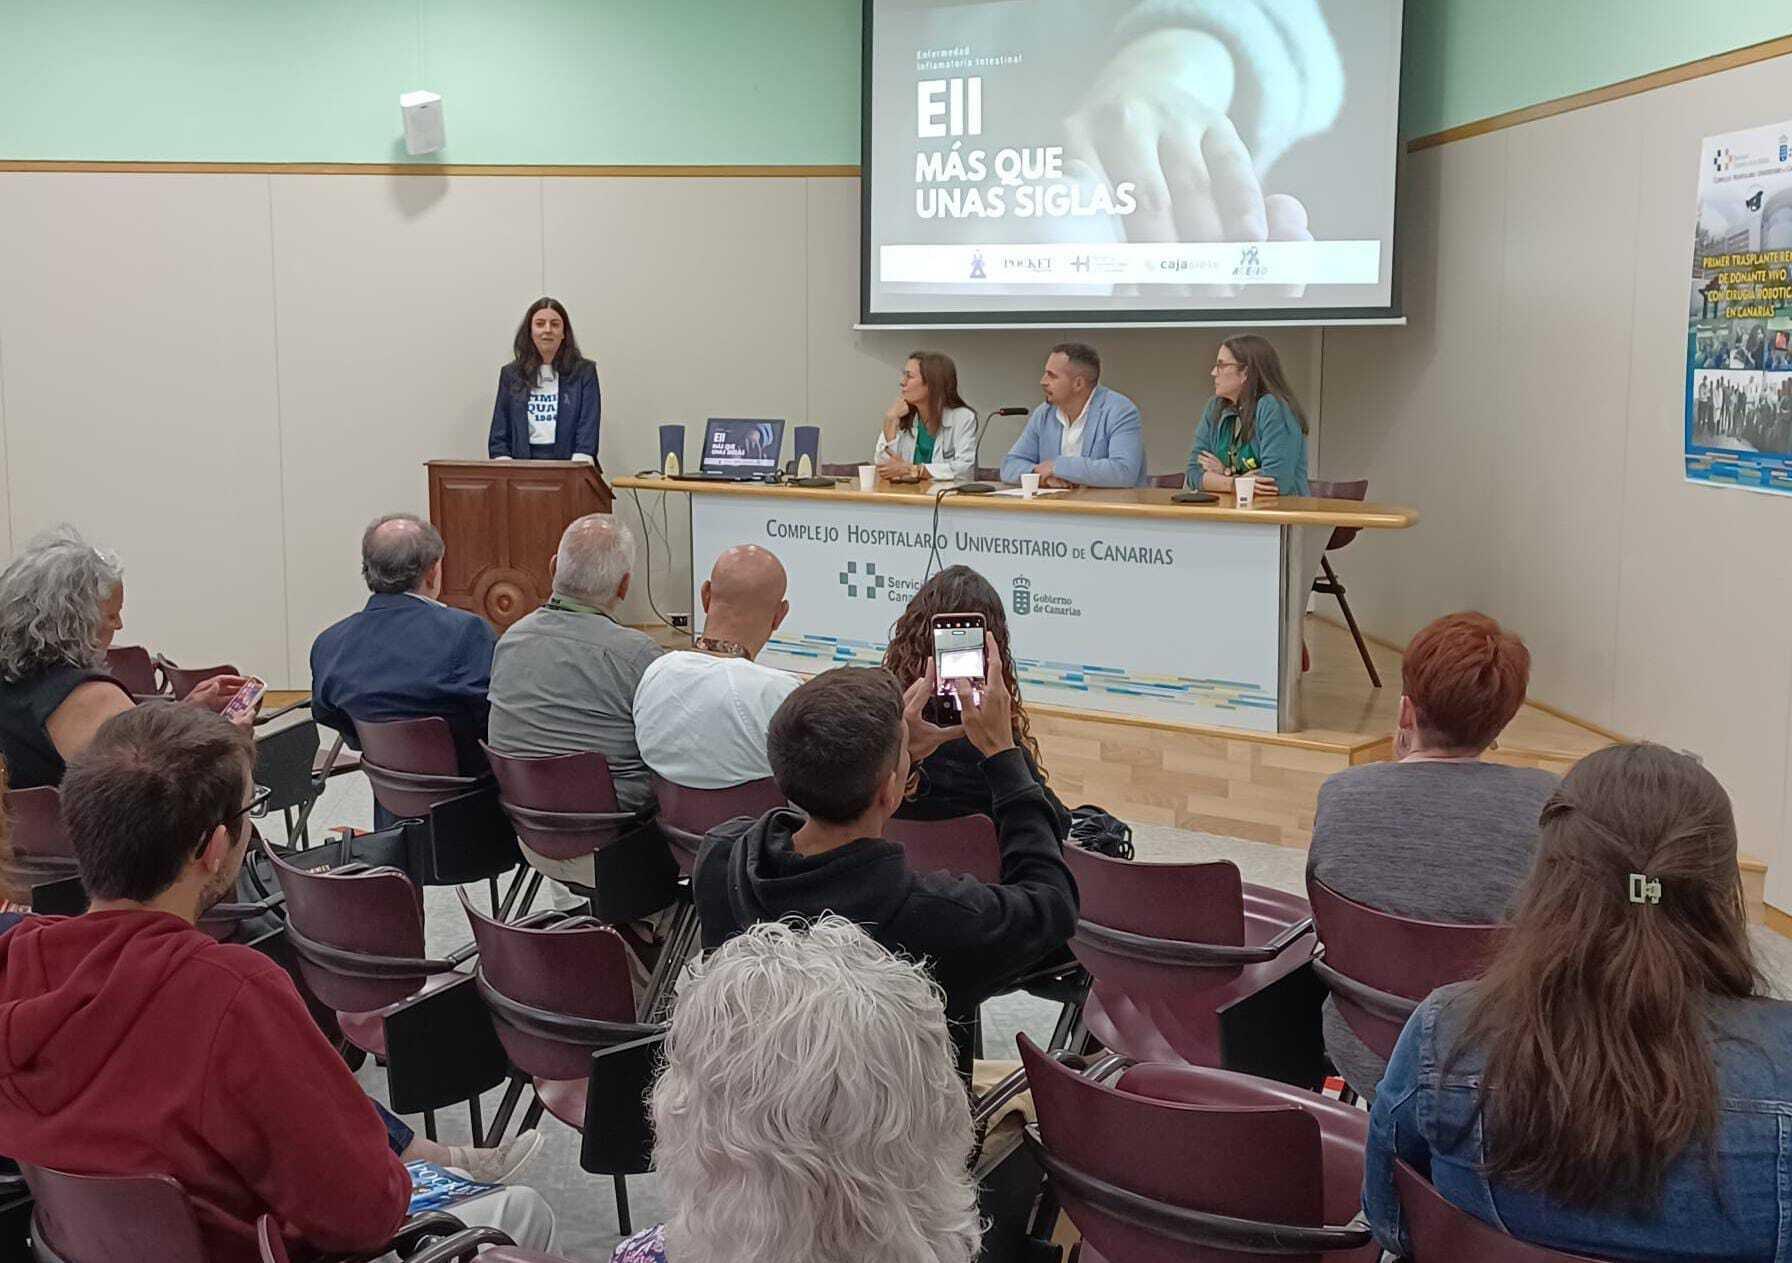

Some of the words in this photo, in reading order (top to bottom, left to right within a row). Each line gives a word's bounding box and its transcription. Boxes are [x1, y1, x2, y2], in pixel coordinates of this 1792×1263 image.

[915, 140, 987, 182] MÁS
[995, 147, 1063, 186] QUE
[915, 187, 1005, 218] UNAS
[1014, 182, 1137, 217] SIGLAS
[766, 519, 839, 543] COMPLEJO
[955, 532, 1067, 558] UNIVERSITARIO
[1072, 547, 1086, 560] DE
[1090, 540, 1174, 566] CANARIAS
[1033, 593, 1072, 606] Gobierno
[1033, 604, 1042, 613] de
[1044, 605, 1082, 617] Canarias
